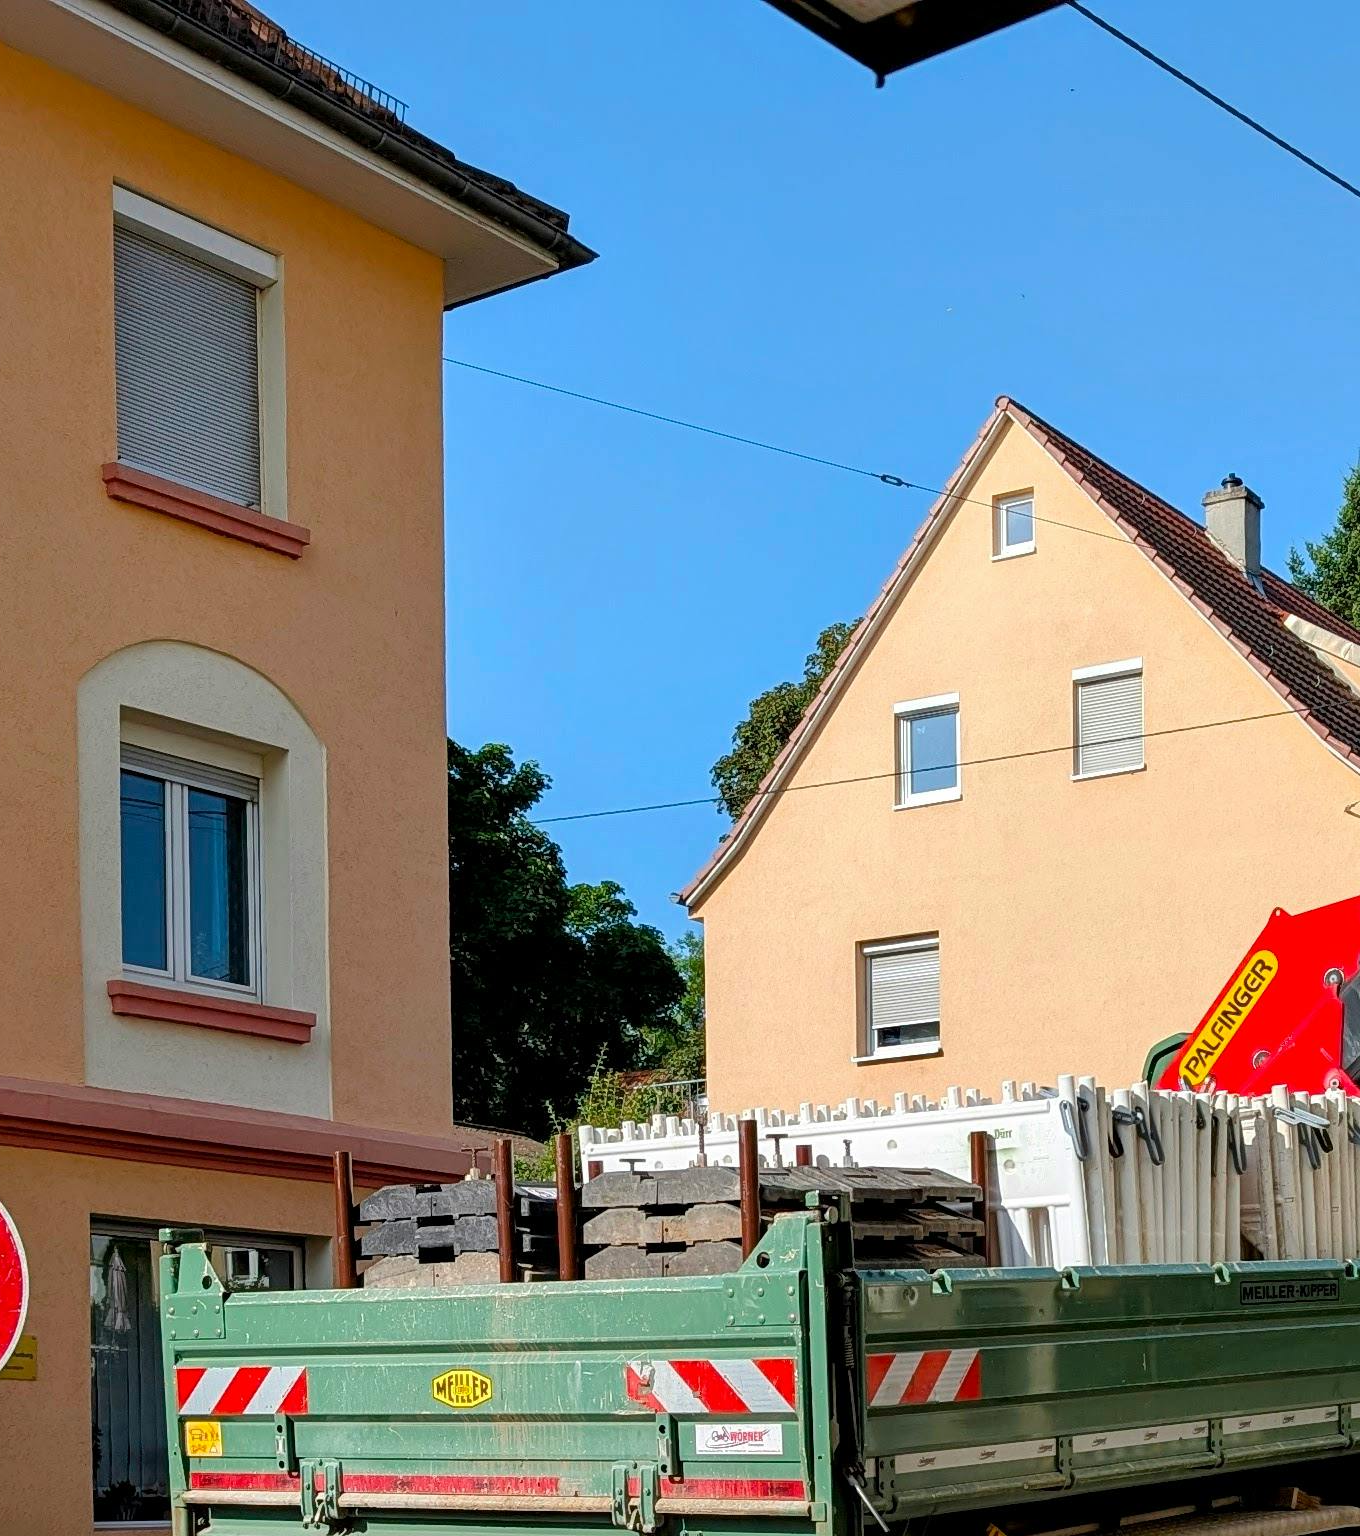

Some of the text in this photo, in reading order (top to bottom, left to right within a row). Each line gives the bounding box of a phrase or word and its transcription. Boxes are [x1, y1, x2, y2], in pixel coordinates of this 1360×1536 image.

[1184, 958, 1273, 1079] PALFINGER
[1242, 1283, 1337, 1301] MEILLER-KIPPER
[436, 1373, 489, 1404] MEILLER
